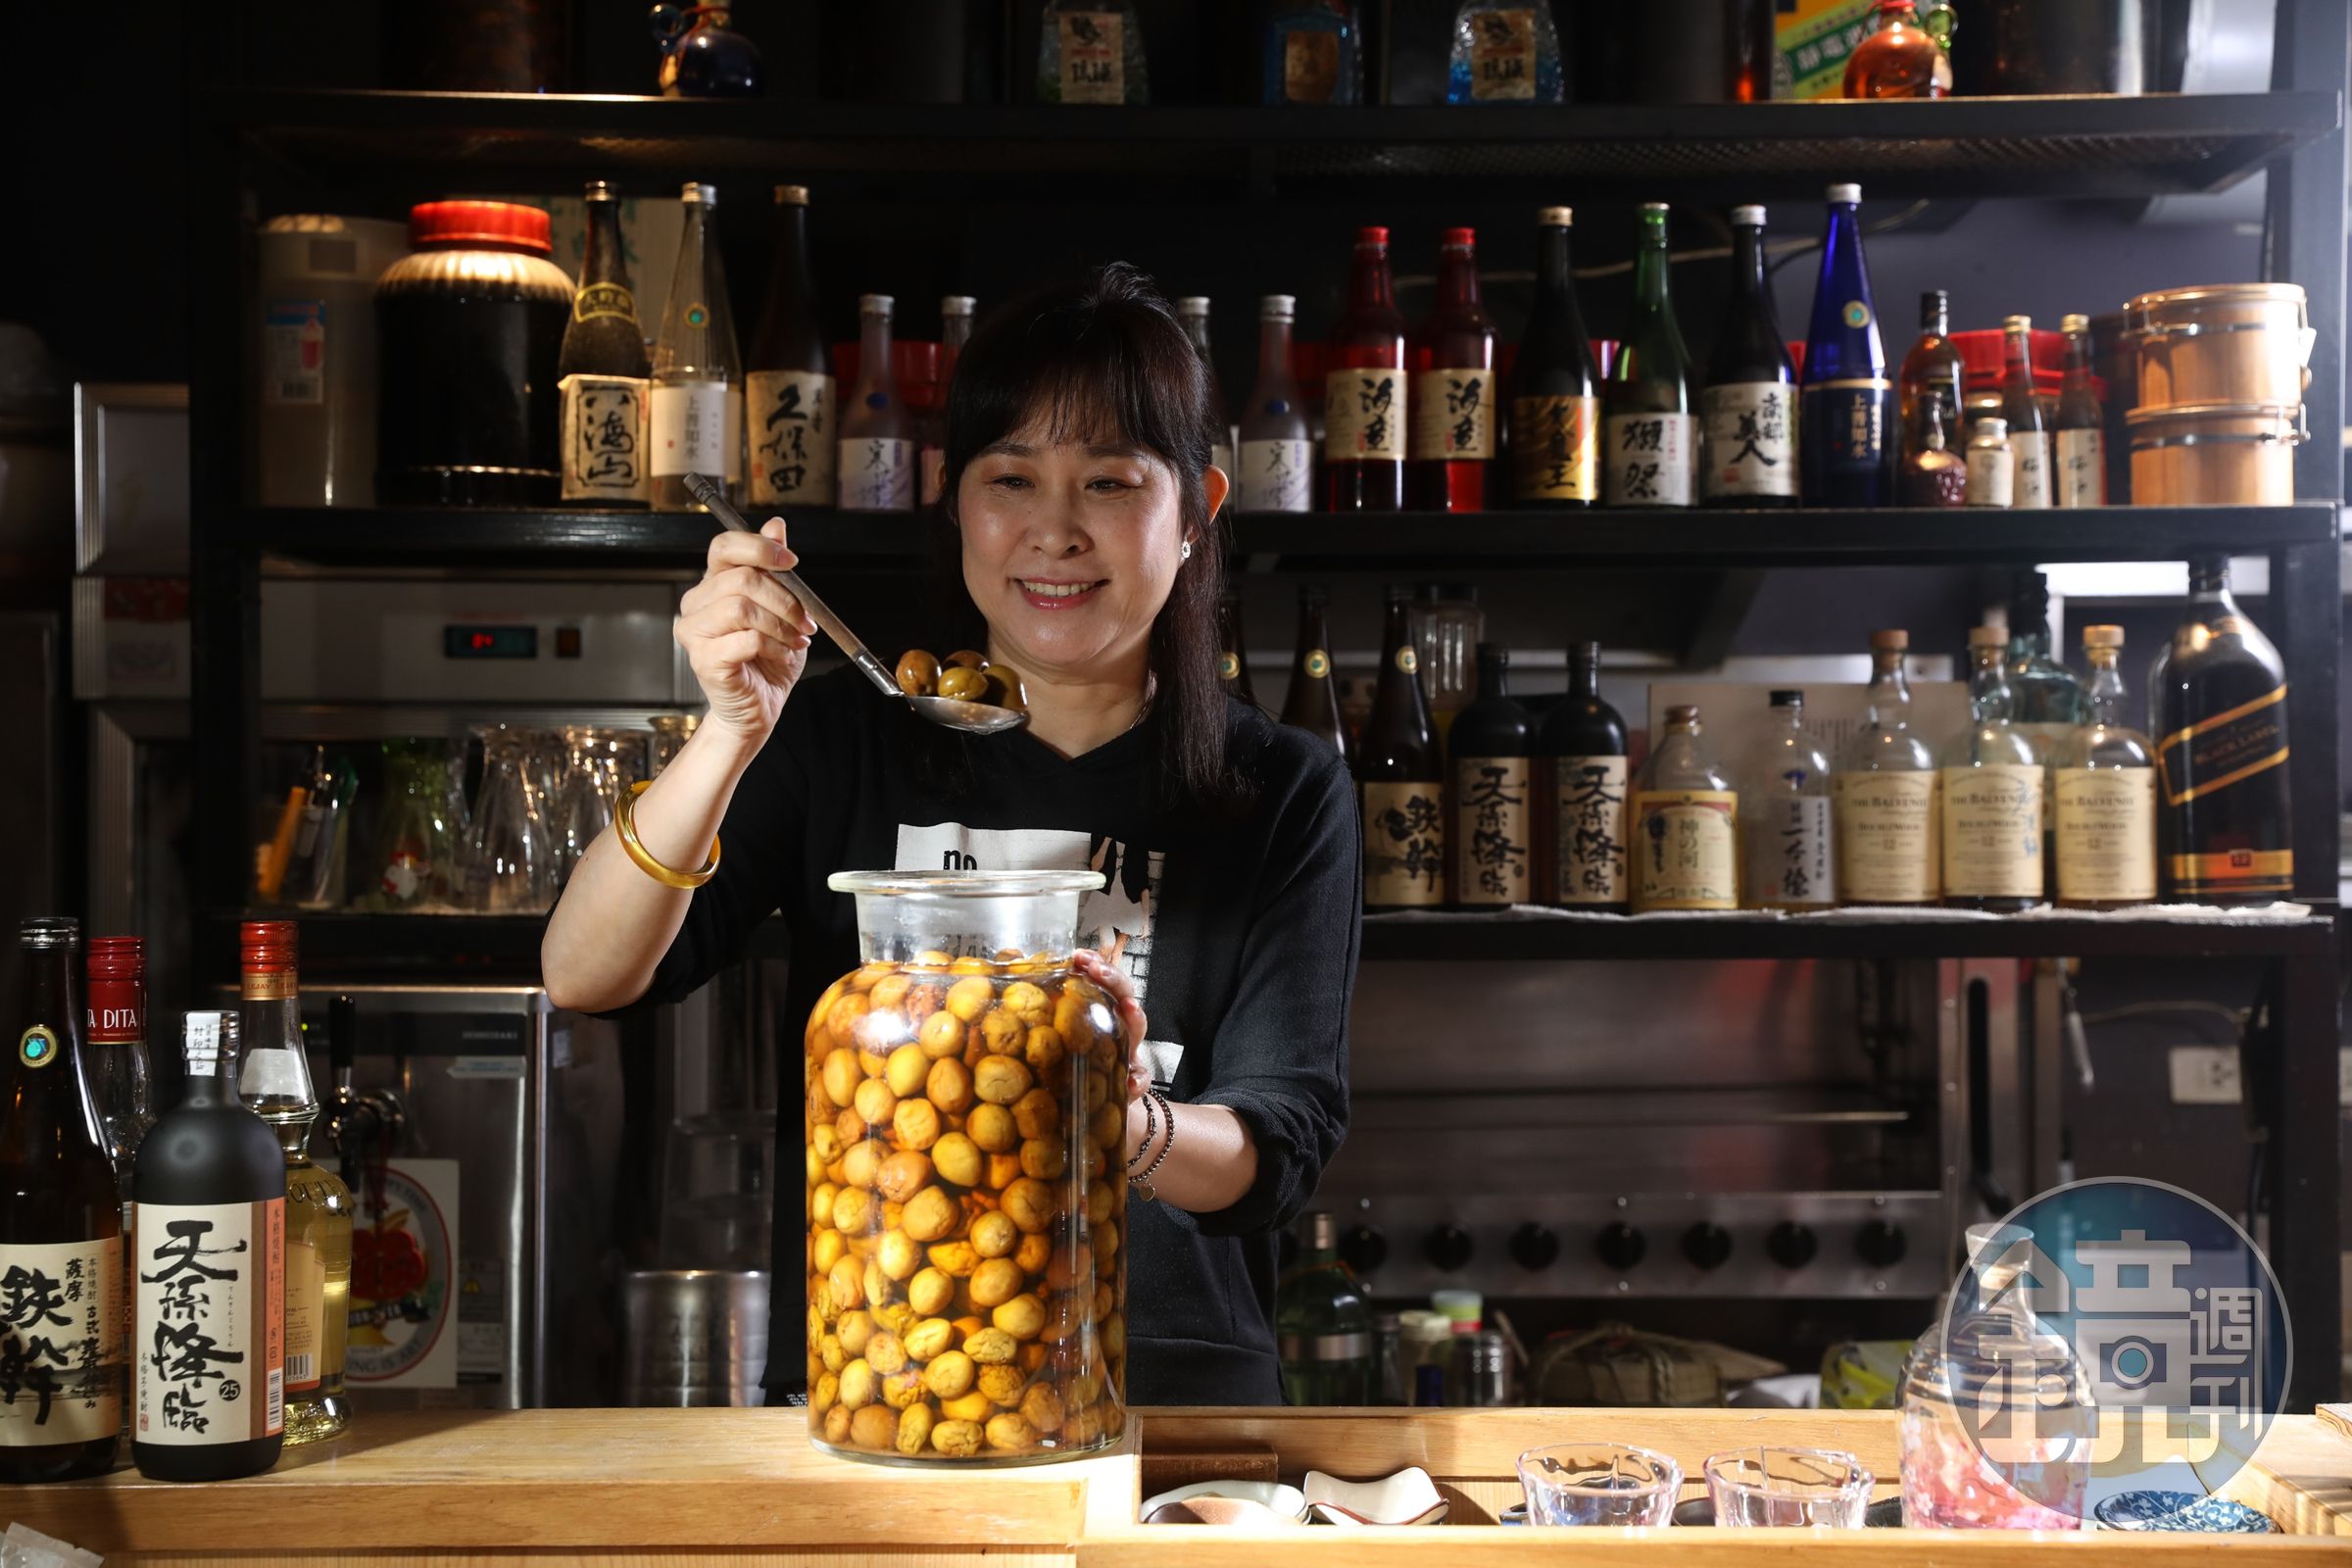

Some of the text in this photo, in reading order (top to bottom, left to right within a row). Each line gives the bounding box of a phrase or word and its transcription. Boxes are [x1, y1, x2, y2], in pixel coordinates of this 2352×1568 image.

[759, 383, 808, 492] 久保田
[1622, 418, 1664, 498] 獺祭
[1679, 817, 1698, 869] 神の河
[103, 1008, 137, 1029] DITA
[65, 1257, 85, 1302] 薩摩
[86, 1256, 97, 1301] 本格焼酎
[0, 1264, 74, 1426] 鉄幹
[140, 1219, 248, 1435] 天孫降臨
[220, 1383, 240, 1398] 25
